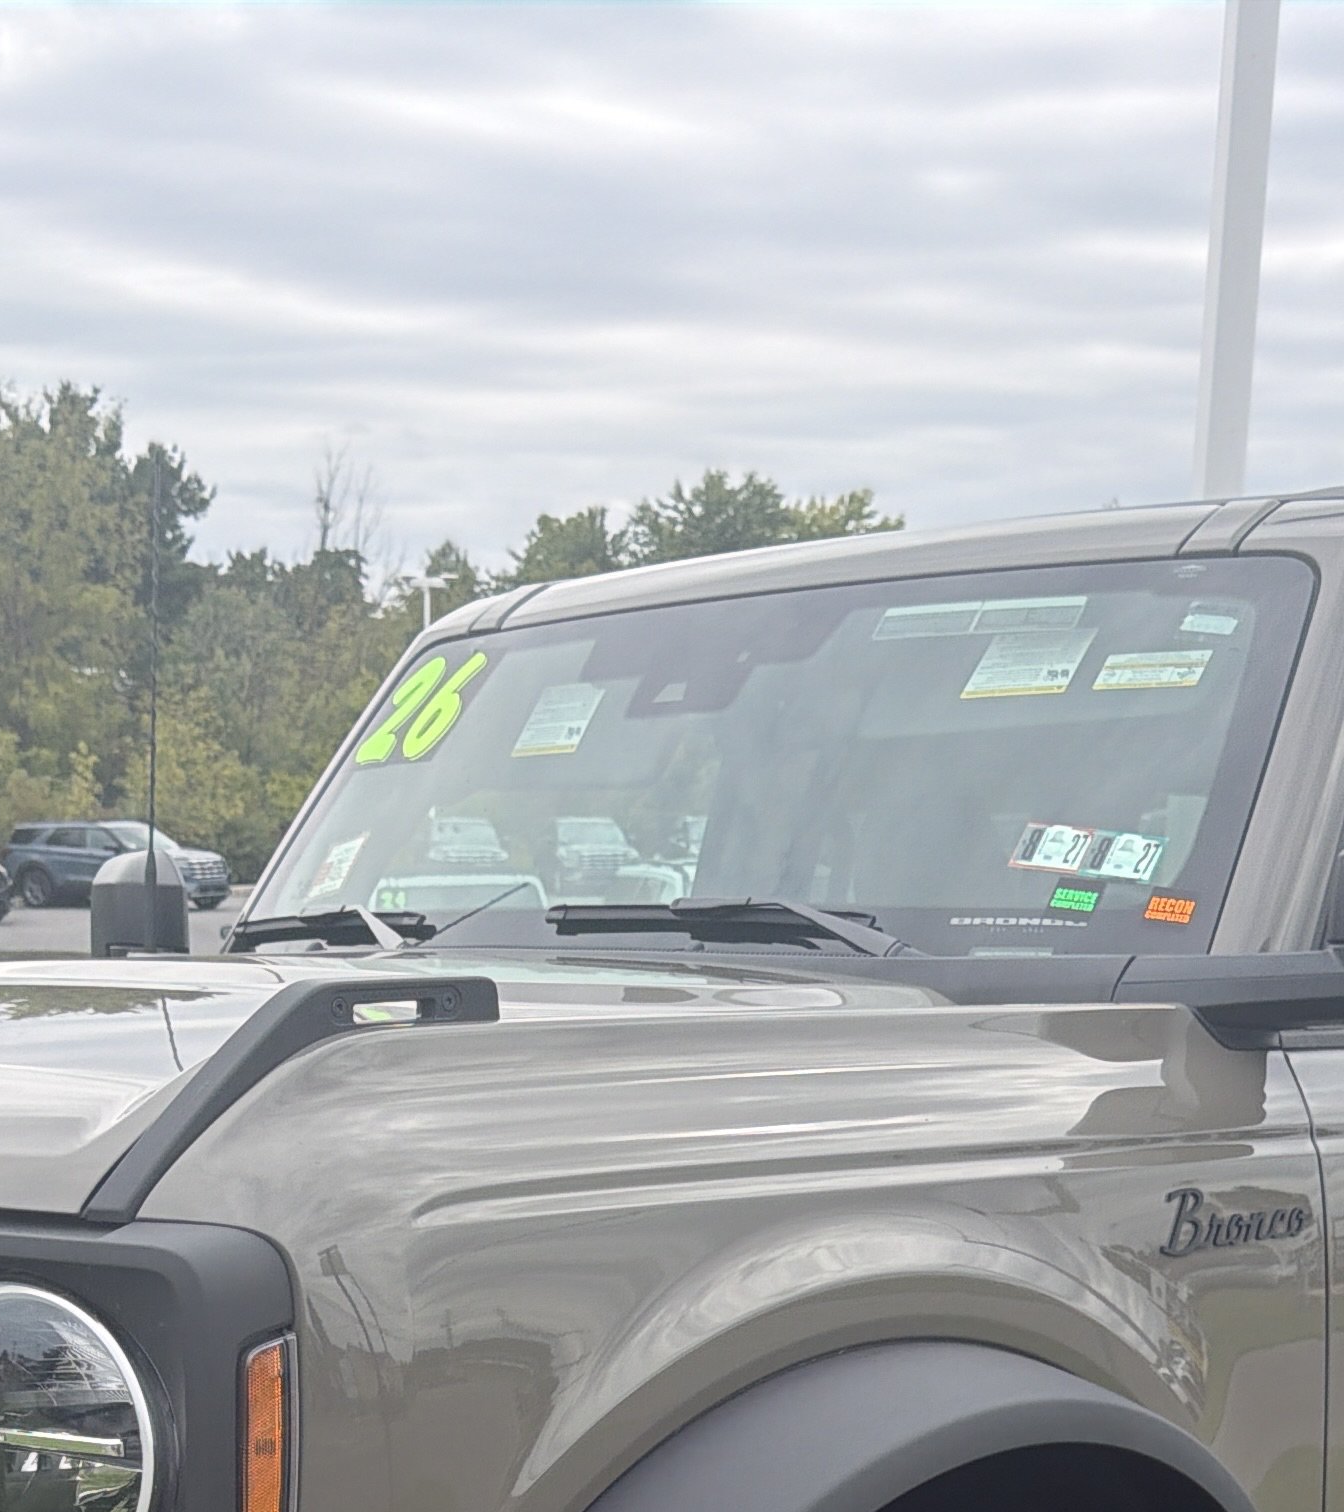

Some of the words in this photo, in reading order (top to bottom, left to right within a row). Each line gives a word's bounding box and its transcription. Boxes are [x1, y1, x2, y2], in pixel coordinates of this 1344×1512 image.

[356, 652, 487, 765] 26
[1062, 833, 1089, 864] 27
[1133, 842, 1160, 874] 27
[1054, 888, 1099, 904] SERVICE
[1148, 896, 1196, 915] RECON
[1159, 1188, 1304, 1257] Bronco
